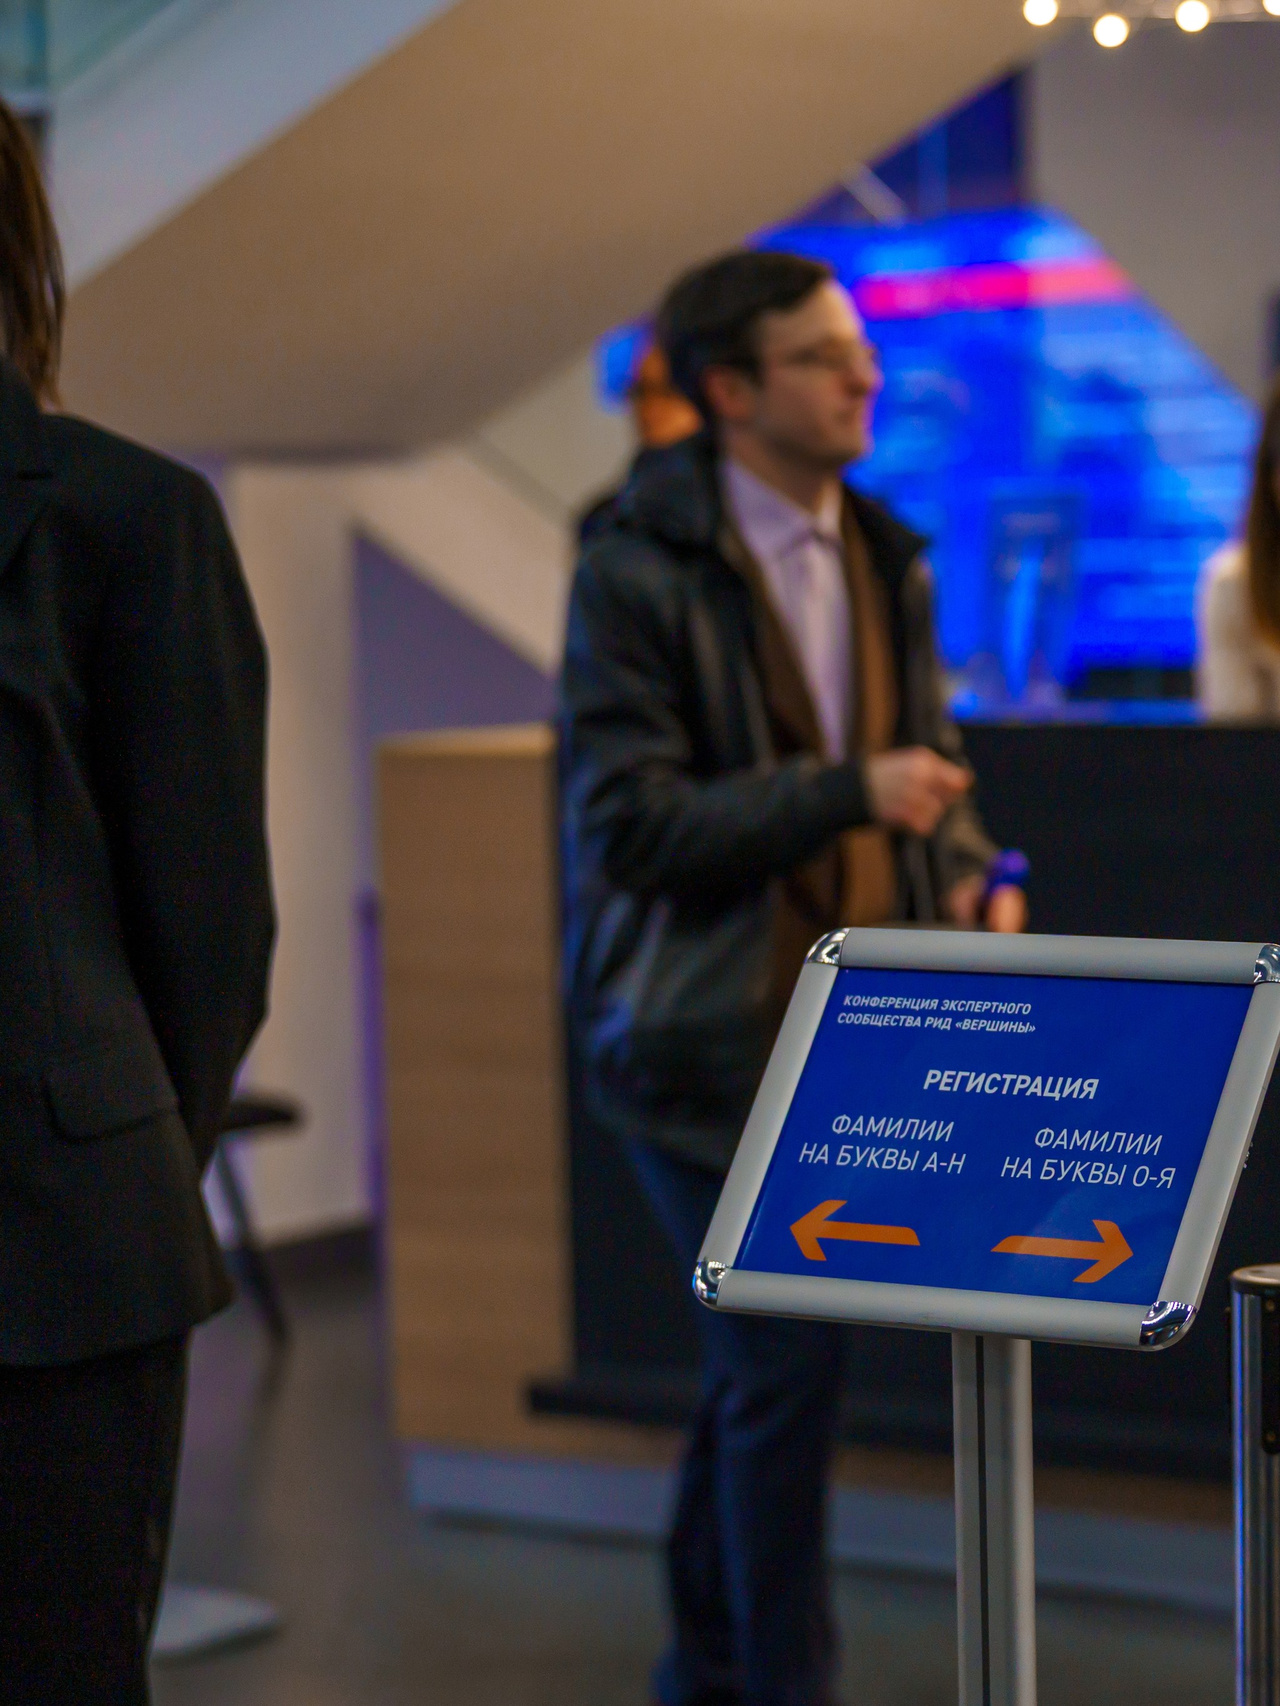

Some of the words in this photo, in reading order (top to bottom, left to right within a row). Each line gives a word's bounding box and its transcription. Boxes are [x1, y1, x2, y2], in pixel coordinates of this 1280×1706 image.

[843, 995, 939, 1011] КОНФЕРЕНЦИЯ
[940, 999, 1032, 1015] ЭКСПЕРТНОГО
[837, 1012, 921, 1027] СООБЩЕСТВА
[924, 1016, 953, 1031] РИД
[955, 1018, 1036, 1033] «ВЕРШИНЫ»
[923, 1069, 1100, 1102] РЕГИСТРАЦИЯ
[832, 1114, 955, 1142] ФАМИЛИИ
[1034, 1127, 1163, 1156] ФАМИЛИИ
[798, 1142, 829, 1165] НА
[835, 1144, 920, 1171] БУКВЫ
[922, 1151, 967, 1174] А-Н
[1000, 1156, 1032, 1179] НА
[1039, 1158, 1127, 1186] БУКВЫ
[1132, 1165, 1176, 1189] О-Я
